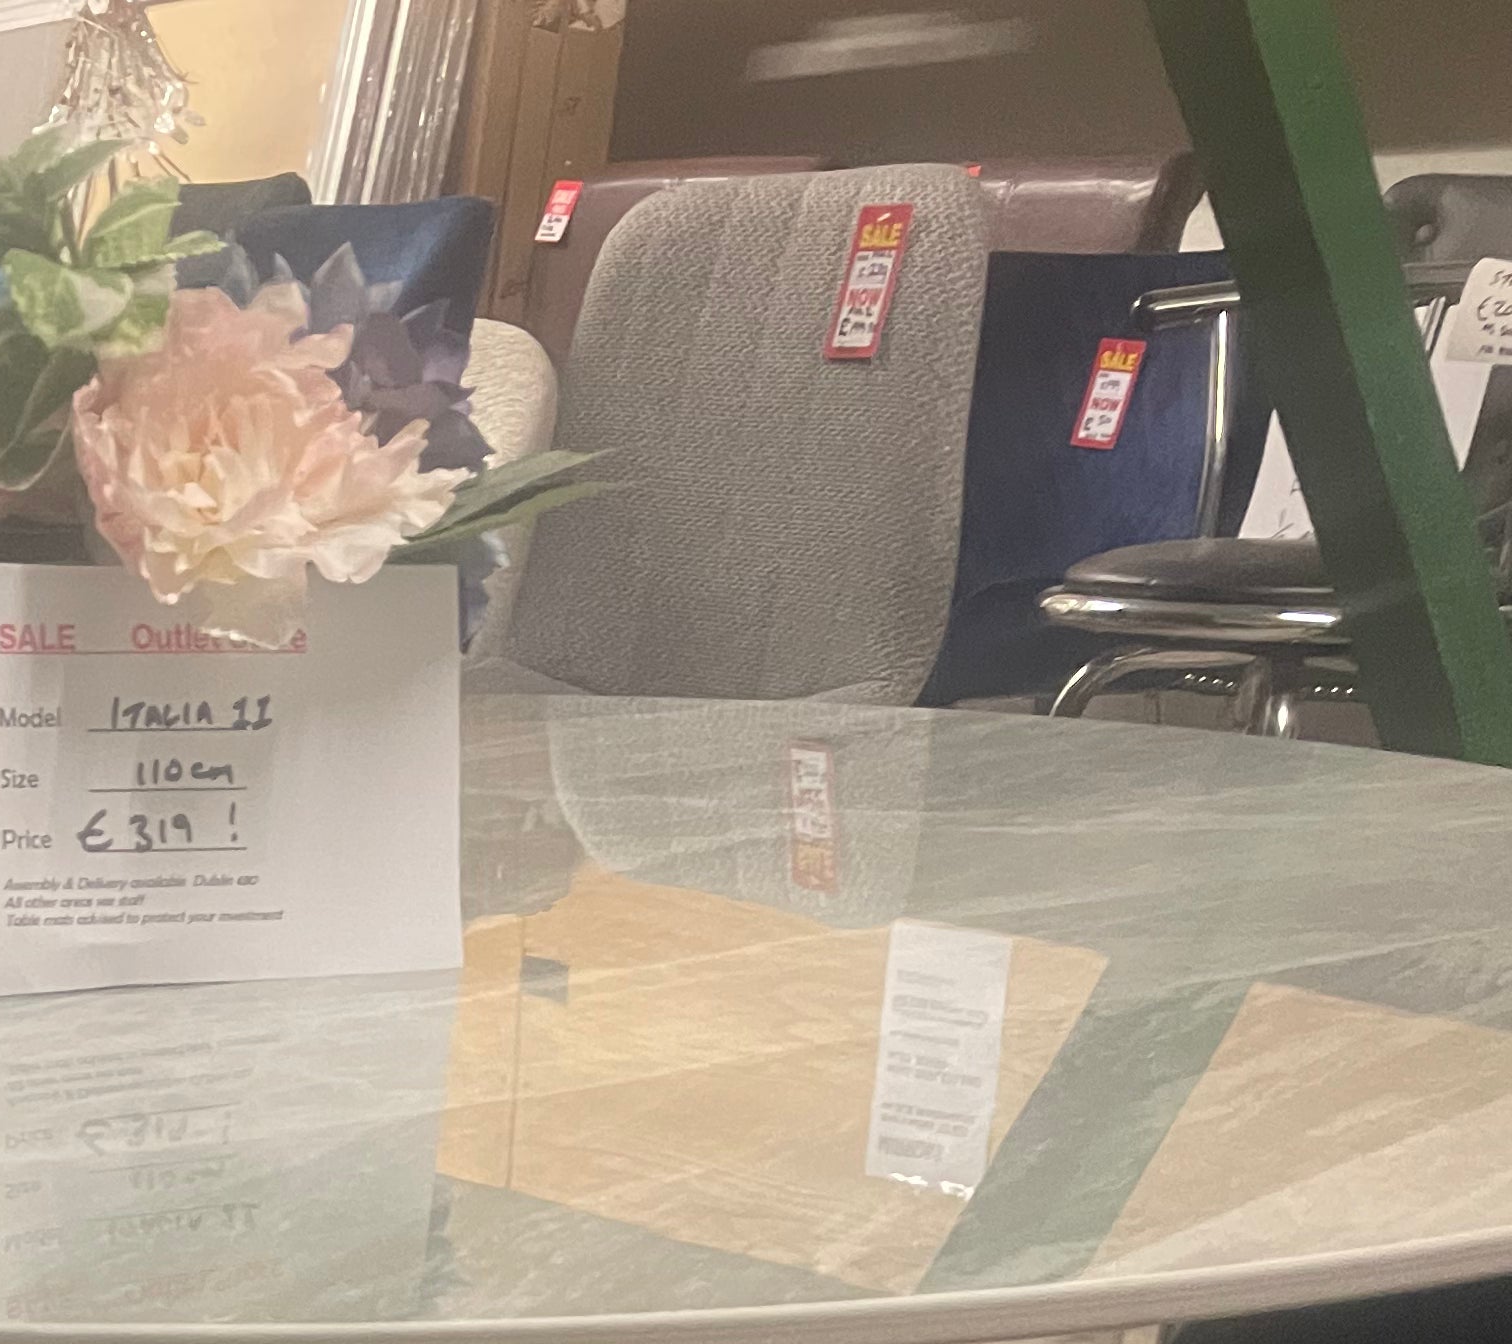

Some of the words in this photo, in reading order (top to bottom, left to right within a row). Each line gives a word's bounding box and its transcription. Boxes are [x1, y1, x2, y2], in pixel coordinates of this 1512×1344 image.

[859, 223, 904, 248] SALE
[847, 289, 884, 307] NOW
[1099, 350, 1140, 373] SALE
[1090, 398, 1121, 412] NOW
[1, 768, 39, 789] Size
[1, 828, 52, 850] Price
